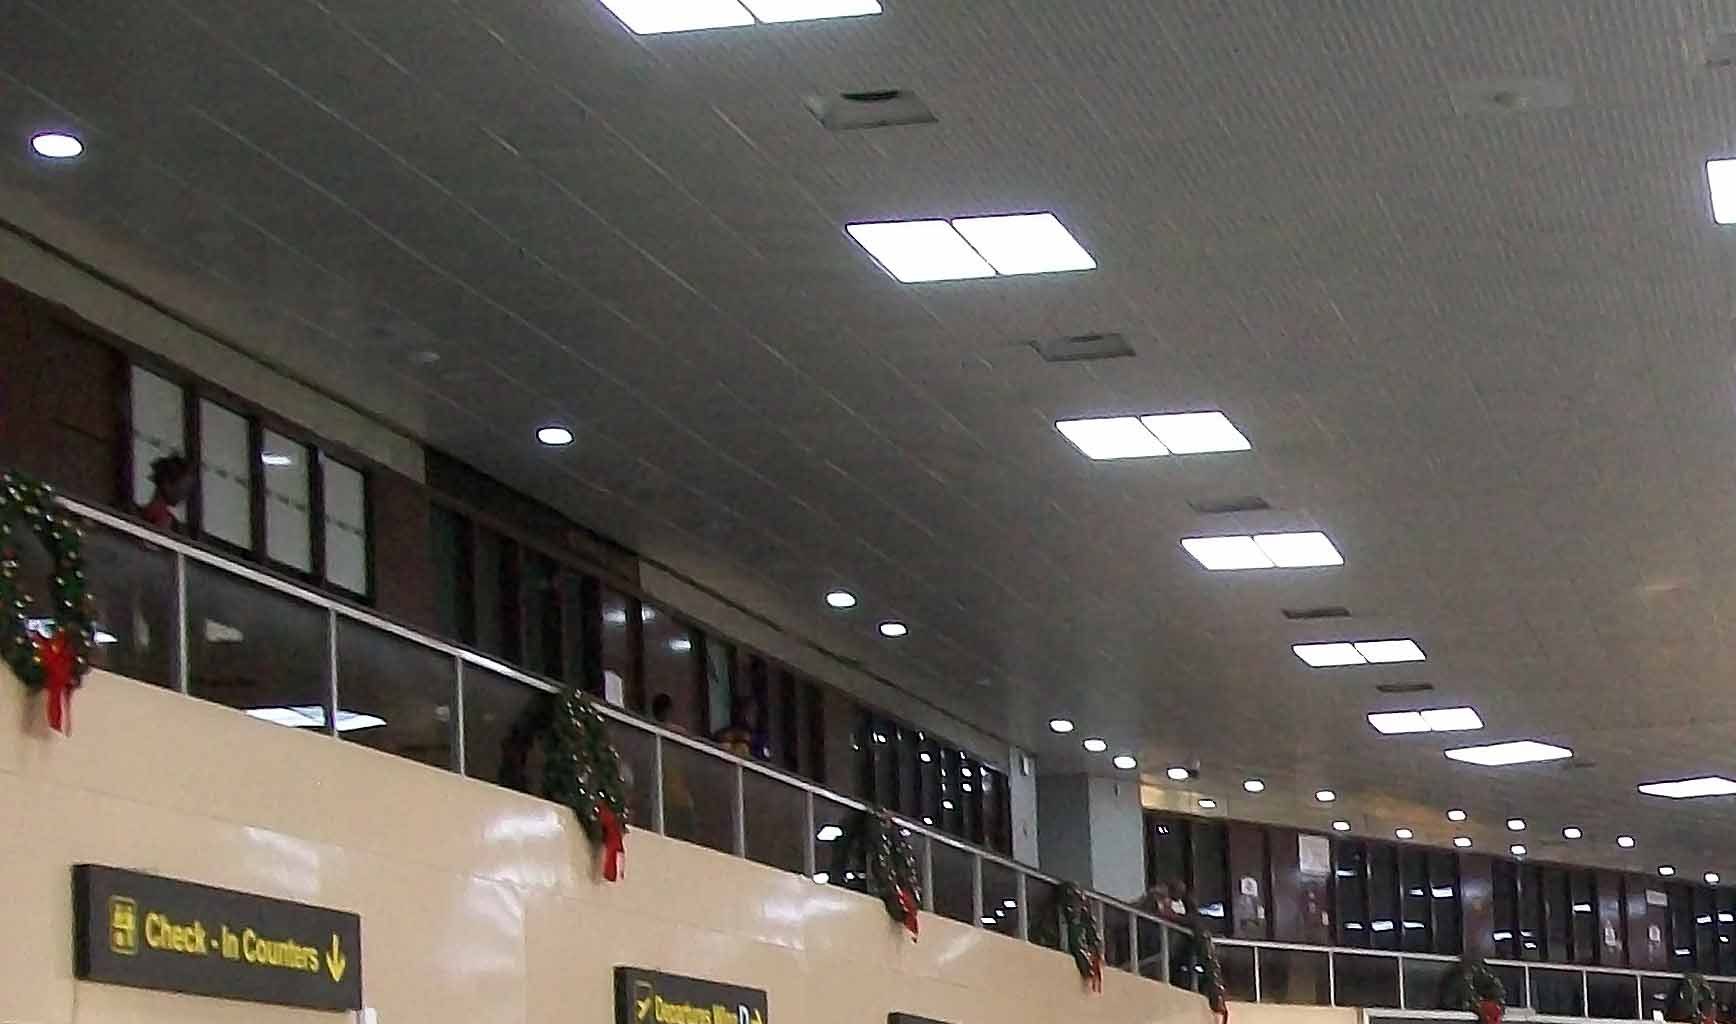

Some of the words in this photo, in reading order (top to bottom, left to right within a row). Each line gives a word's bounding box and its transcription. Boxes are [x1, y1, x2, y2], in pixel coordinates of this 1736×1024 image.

[145, 912, 206, 955] Check
[221, 925, 240, 959] In
[242, 928, 319, 971] Counters
